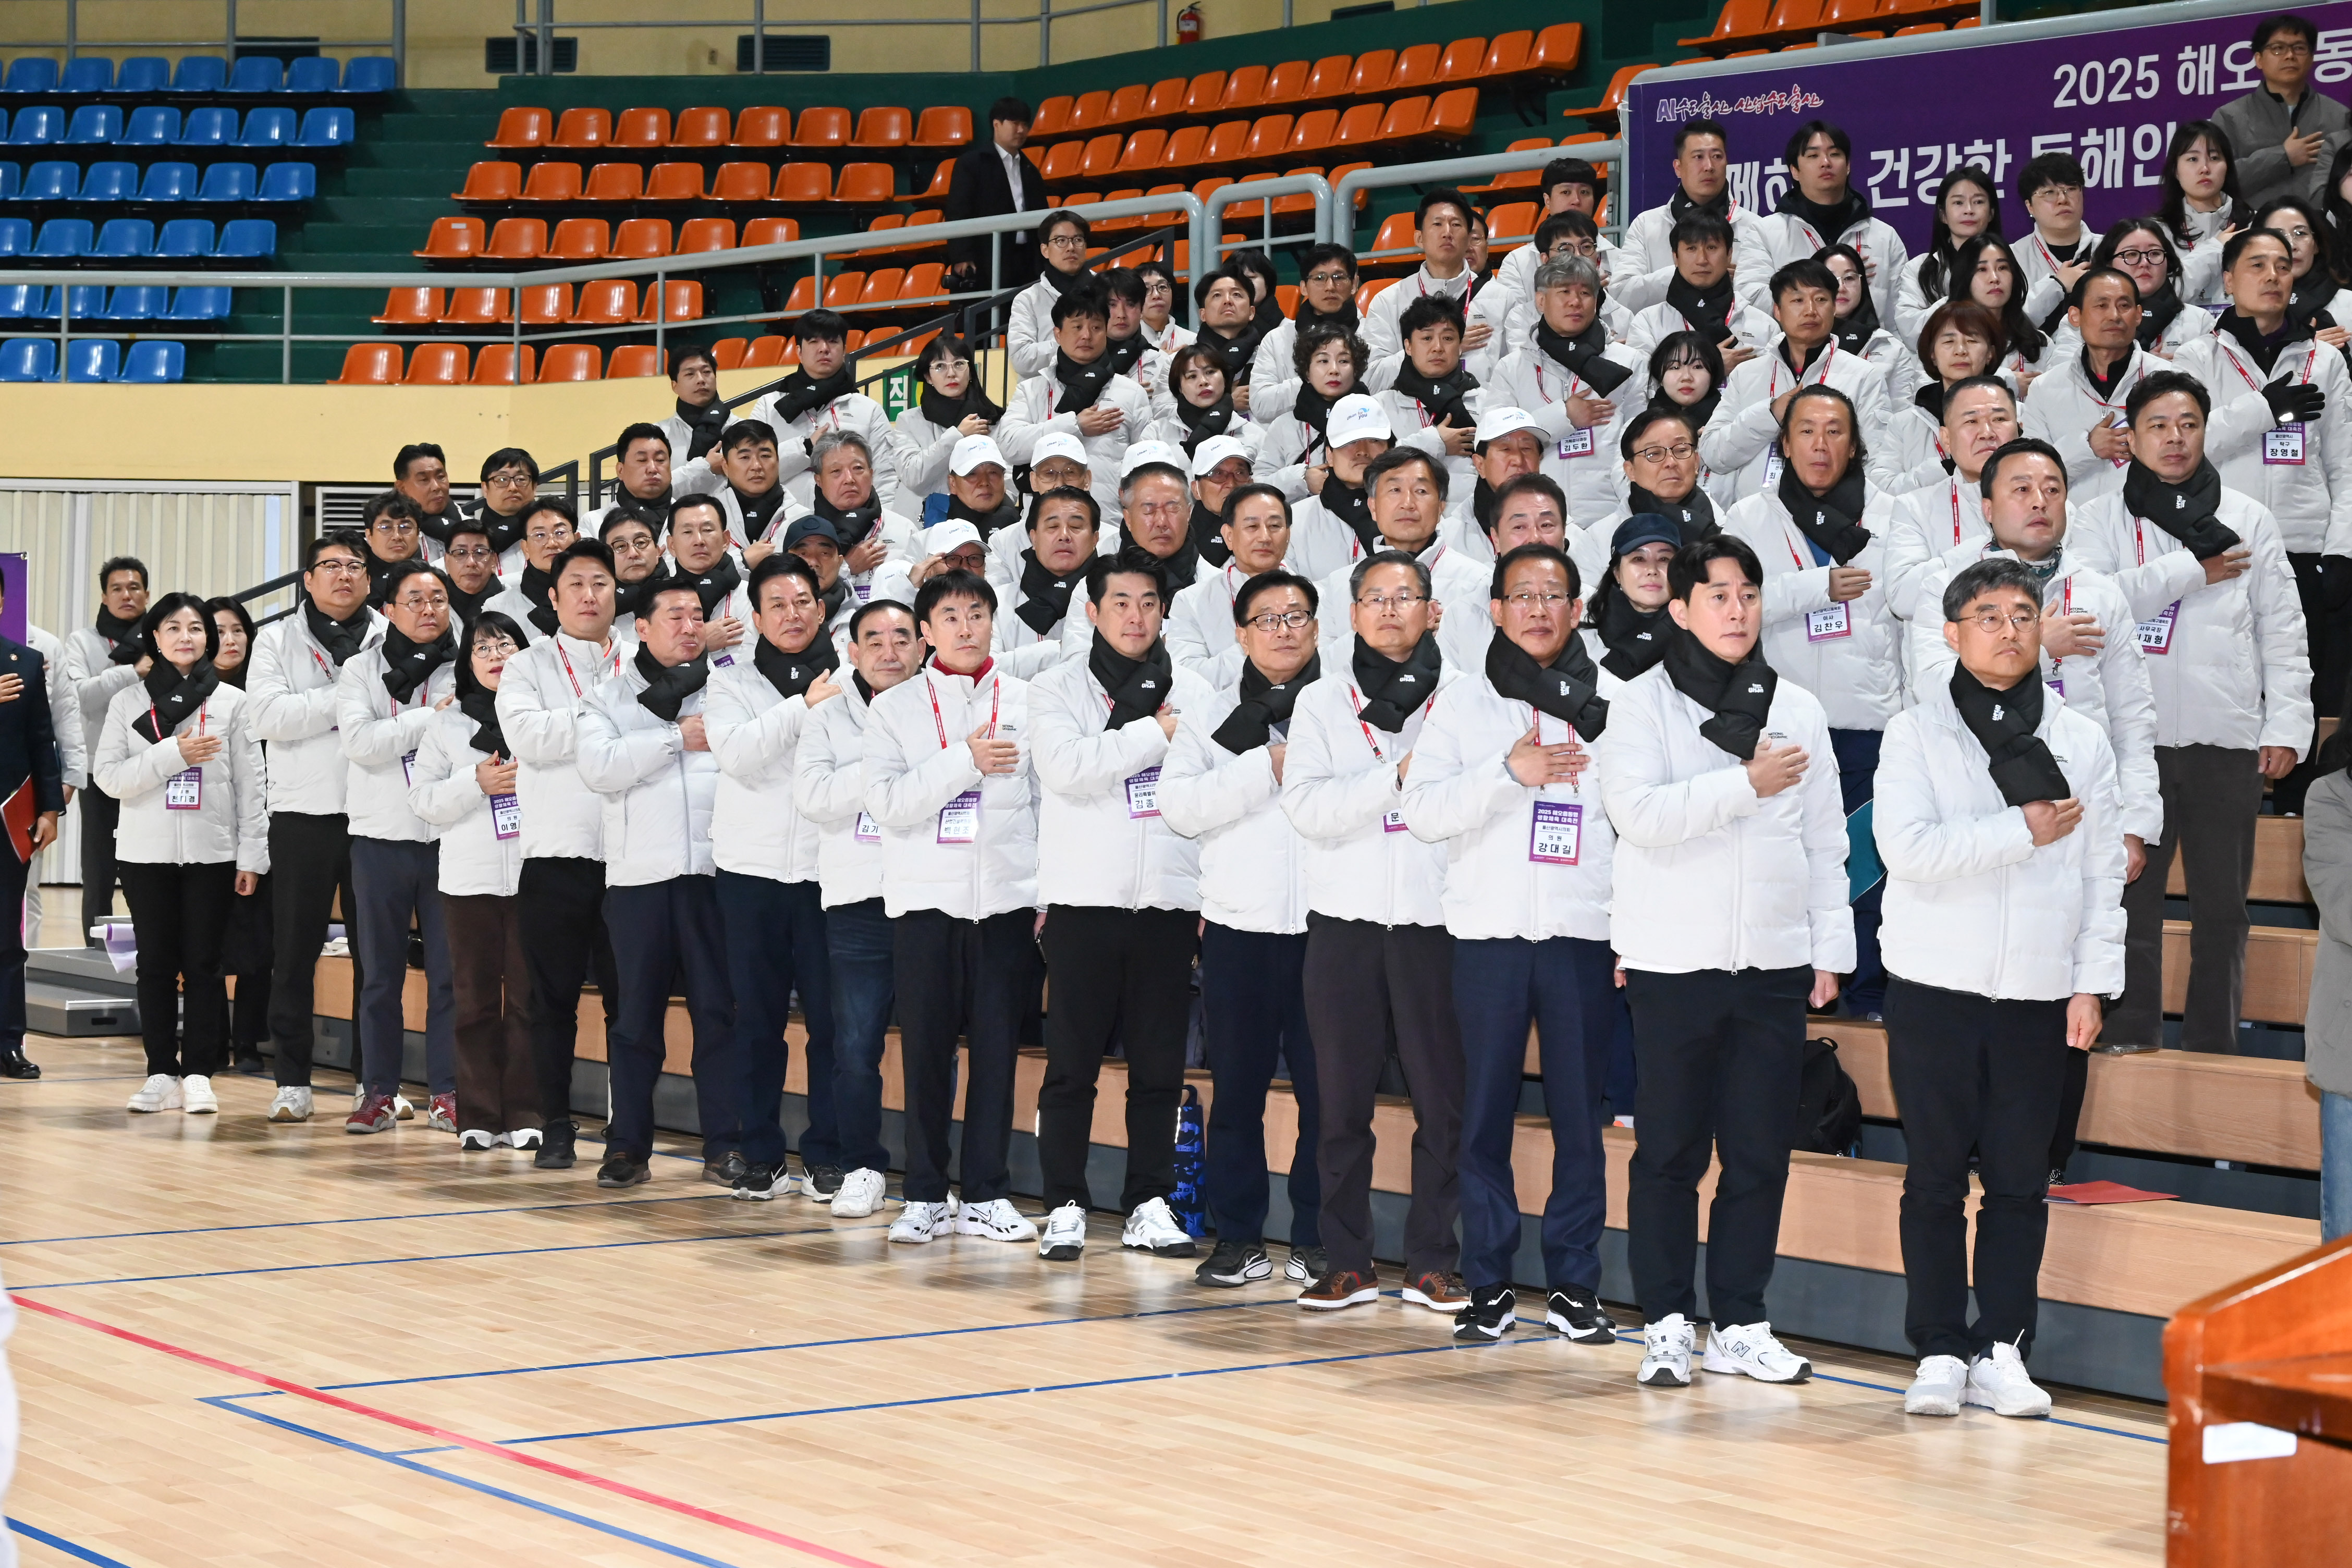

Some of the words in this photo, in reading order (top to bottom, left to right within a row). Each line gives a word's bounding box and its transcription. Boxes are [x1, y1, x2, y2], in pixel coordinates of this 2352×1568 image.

[2053, 54, 2160, 108] 2025
[1867, 139, 2013, 209] 건강한
[1992, 704, 2001, 720] Ulsan
